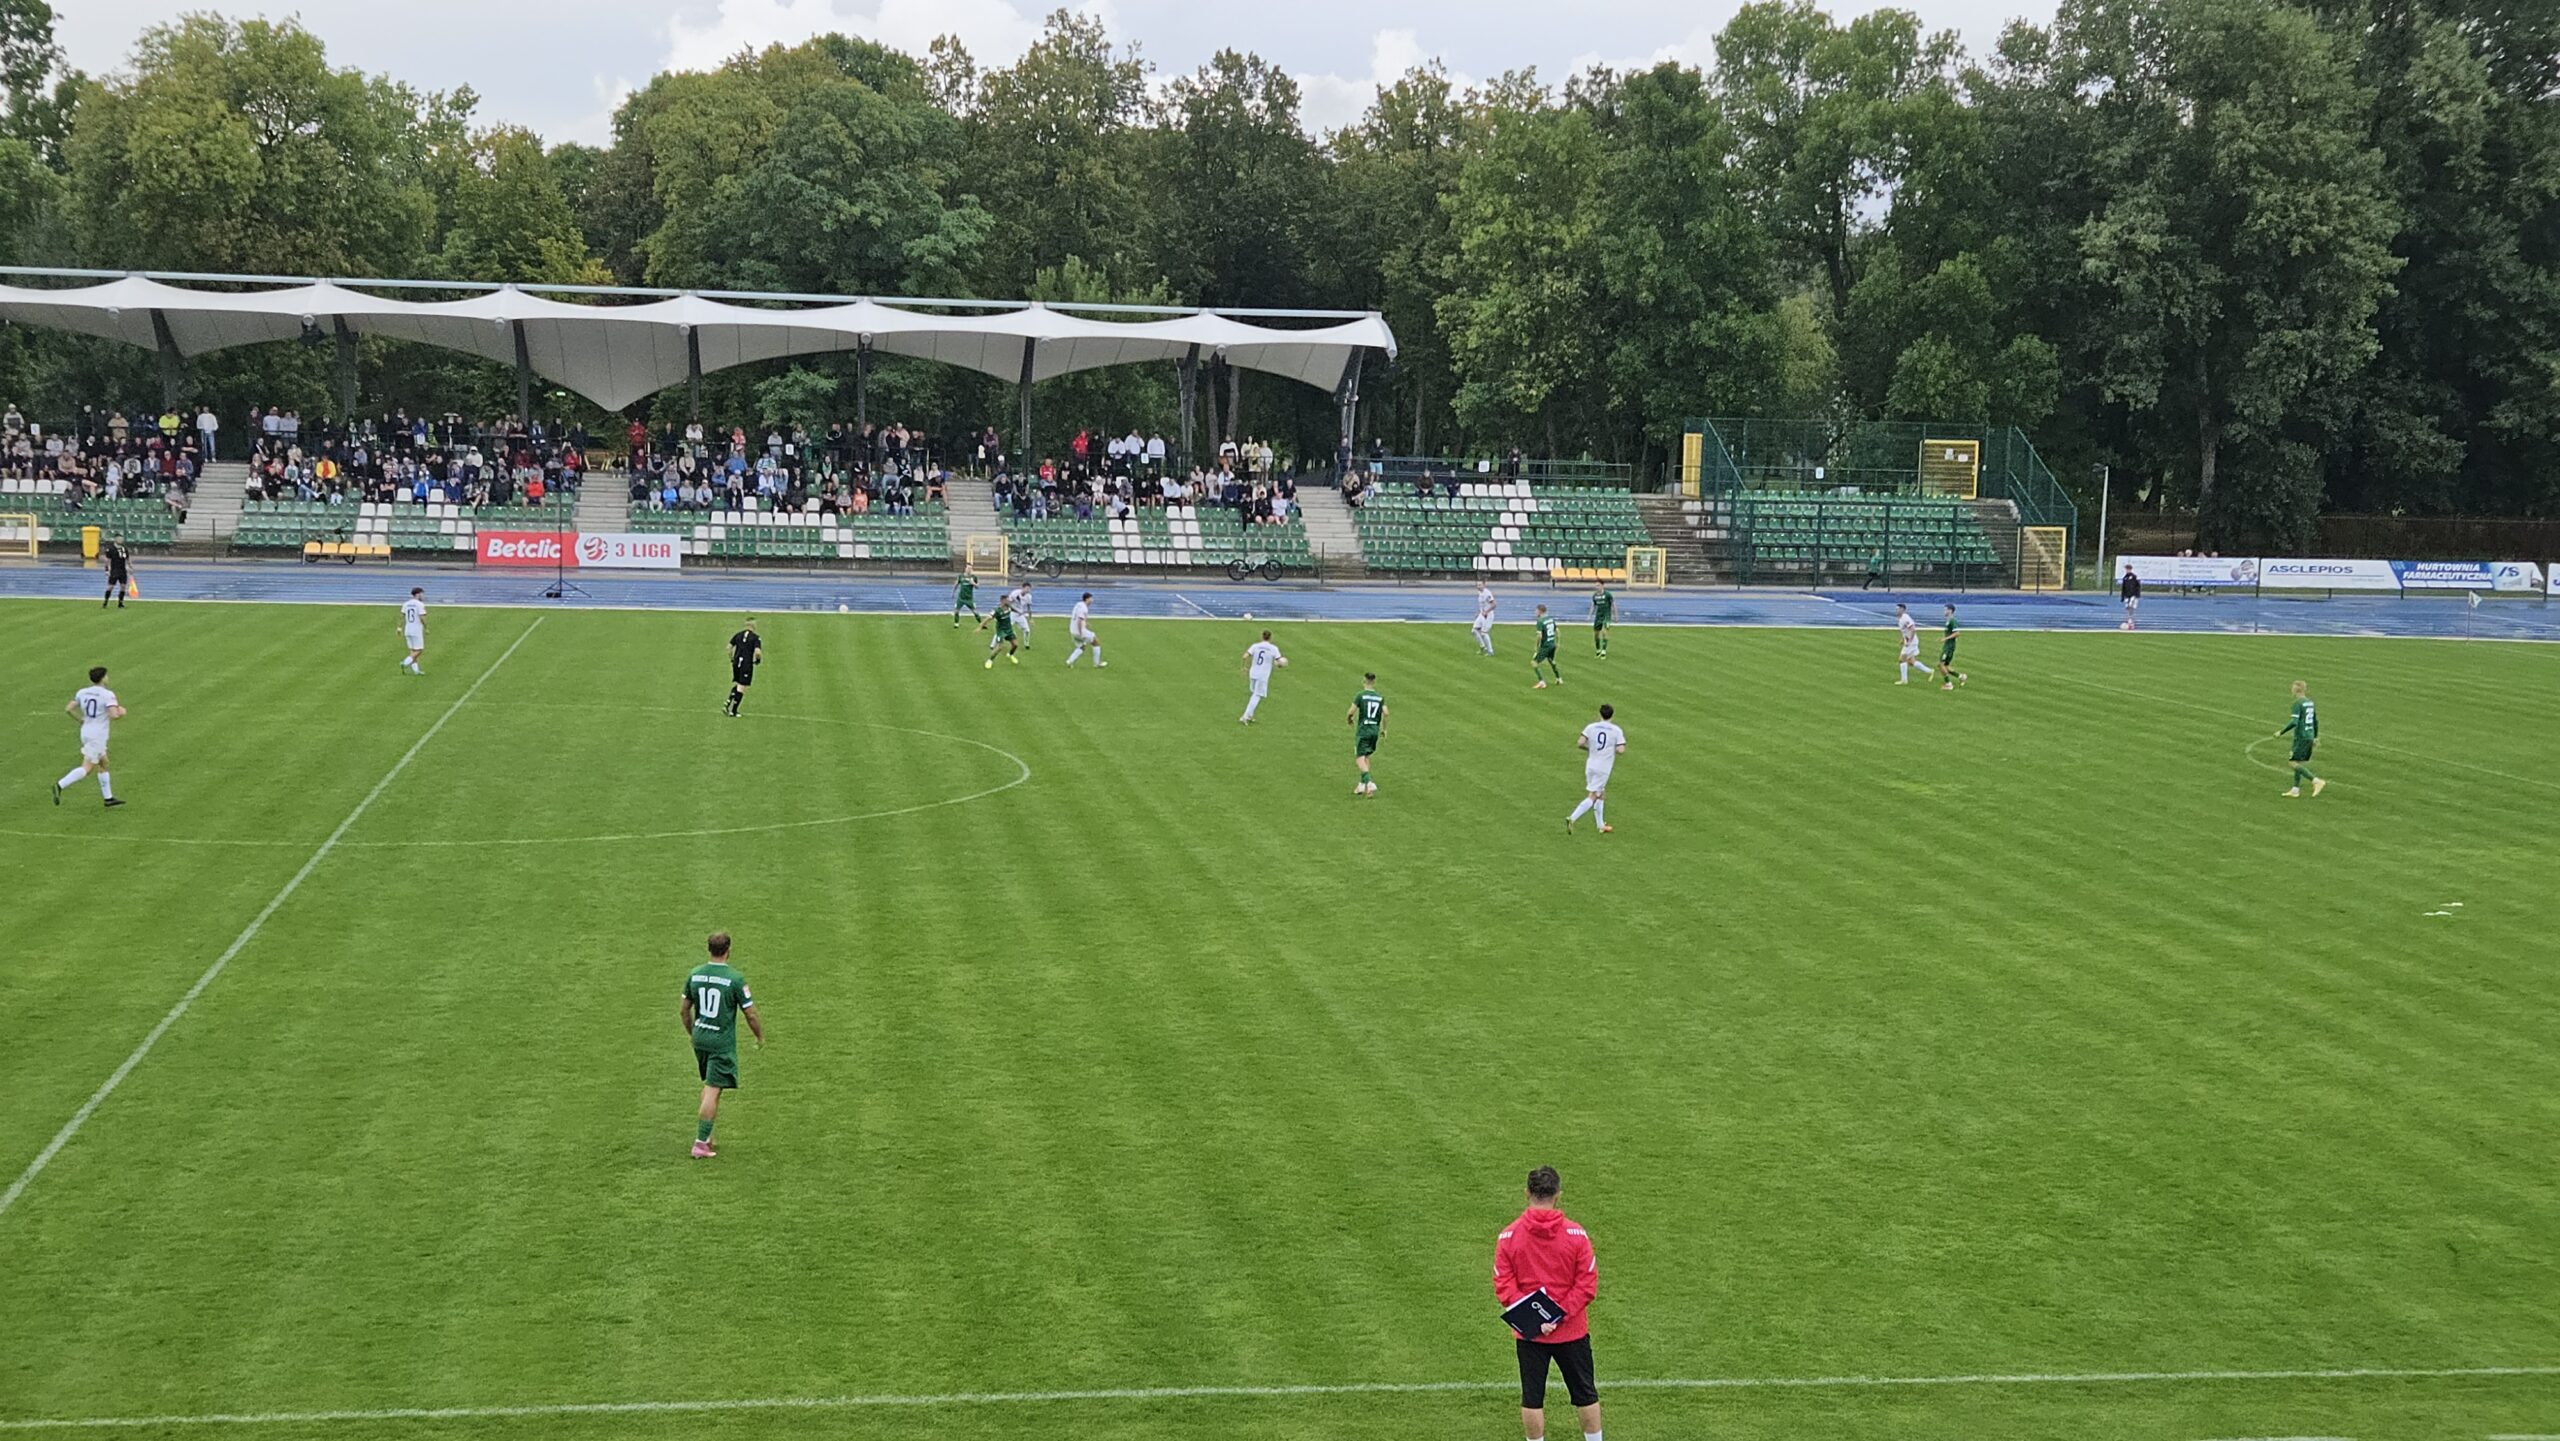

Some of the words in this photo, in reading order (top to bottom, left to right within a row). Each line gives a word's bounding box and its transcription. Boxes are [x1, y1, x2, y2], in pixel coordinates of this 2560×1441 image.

[487, 538, 561, 558] Betclic
[615, 542, 625, 557] 3
[632, 543, 671, 558] LIGA
[2268, 565, 2353, 574] ASCLEPIOS
[2416, 562, 2480, 572] HURTOWNIA
[2402, 571, 2493, 581] FARMACEUTYCZNA
[1256, 650, 1265, 665] 6
[1367, 701, 1380, 718] 17
[1597, 731, 1607, 751] 9
[698, 987, 721, 1018] 10
